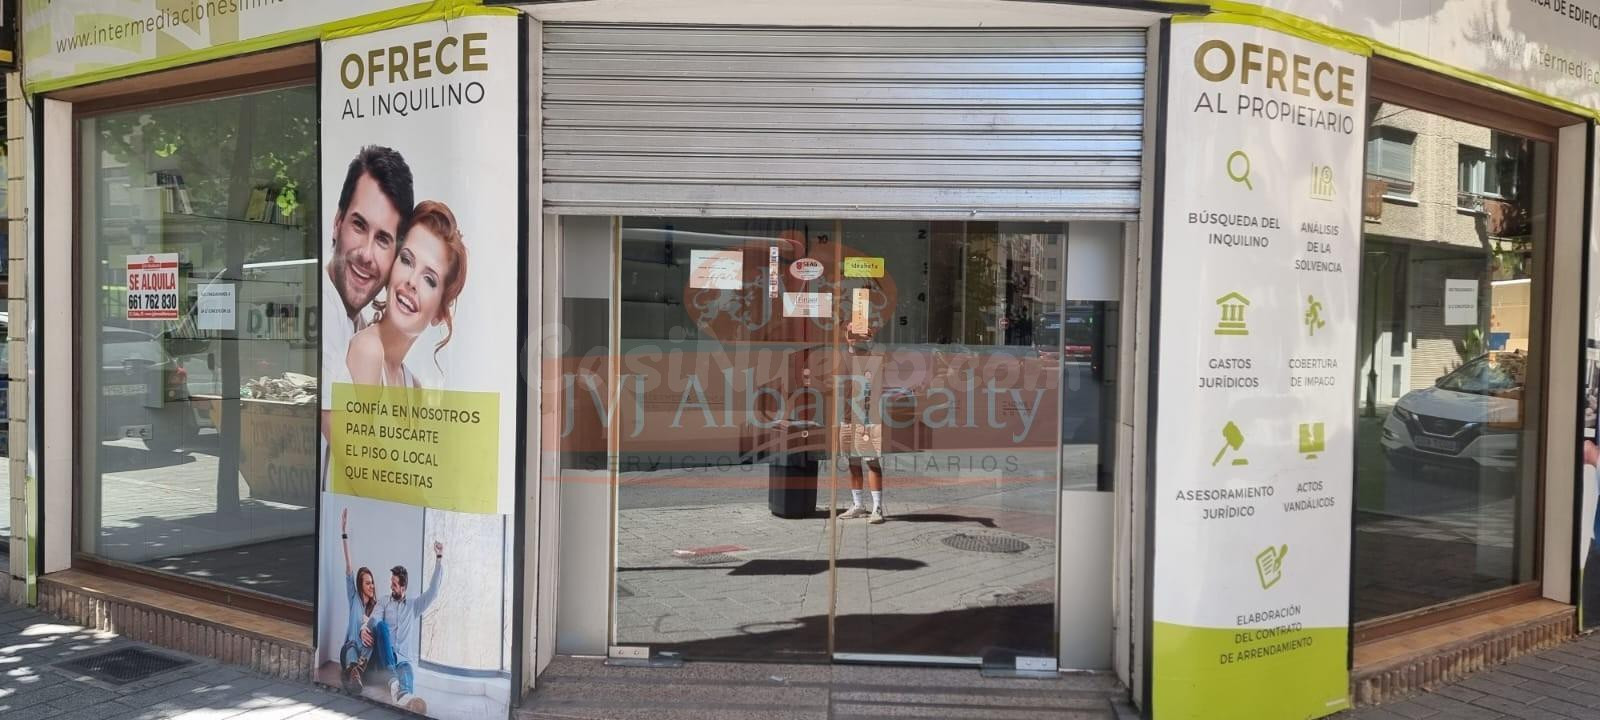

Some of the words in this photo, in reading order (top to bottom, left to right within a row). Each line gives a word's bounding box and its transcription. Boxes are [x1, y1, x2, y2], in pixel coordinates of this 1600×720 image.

[1554, 0, 1566, 15] DE
[1569, 3, 1600, 30] EDIFIC
[340, 33, 488, 90] OFRECE
[1194, 39, 1355, 106] OFRECE
[342, 98, 364, 120] AL
[372, 81, 485, 117] INQUILINO
[1194, 92, 1228, 114] AL
[1237, 94, 1354, 135] PROPIETARIO
[1188, 210, 1259, 228] BÚSQUEDA
[1261, 217, 1281, 230] DEL
[1300, 220, 1340, 236] ANÁLISIS
[1208, 233, 1269, 248] INQUILINO
[1306, 241, 1319, 253] DE
[1321, 243, 1332, 254] LA
[1295, 259, 1342, 273] SOLVENCIA
[129, 273, 139, 290] SE
[142, 272, 176, 292] ALQUILA
[128, 295, 143, 310] 661
[145, 294, 159, 310] 762
[161, 294, 177, 310] 830
[1208, 358, 1252, 369] GASTOS
[1288, 359, 1338, 369] COBERTURA
[1198, 375, 1260, 388] JURÍDICOS
[1290, 377, 1302, 387] DE
[1305, 376, 1336, 387] IMPAGO
[346, 401, 388, 416] CONFÍA
[392, 405, 407, 418] EN
[411, 406, 481, 424] NOSOTROS
[346, 422, 376, 437] PARA
[379, 425, 439, 443] BUSCARTE
[346, 444, 358, 457] EL
[361, 445, 387, 460] PISO
[390, 449, 399, 461] O
[403, 450, 439, 467] LOCAL
[344, 465, 369, 480] QUE
[372, 469, 433, 488] NECESITAS
[1297, 480, 1323, 493] ACTOS
[1175, 486, 1274, 501] ASESORAMIENTO
[1202, 504, 1255, 520] JURÍDICO
[1283, 497, 1335, 513] VANDÁLICOS
[1236, 604, 1301, 626] ELABORACIÓN
[1234, 632, 1253, 645] DEL
[1255, 622, 1303, 640] CONTRATO
[1219, 653, 1234, 665] DE
[1236, 637, 1313, 662] ARRENDAMIENTO
